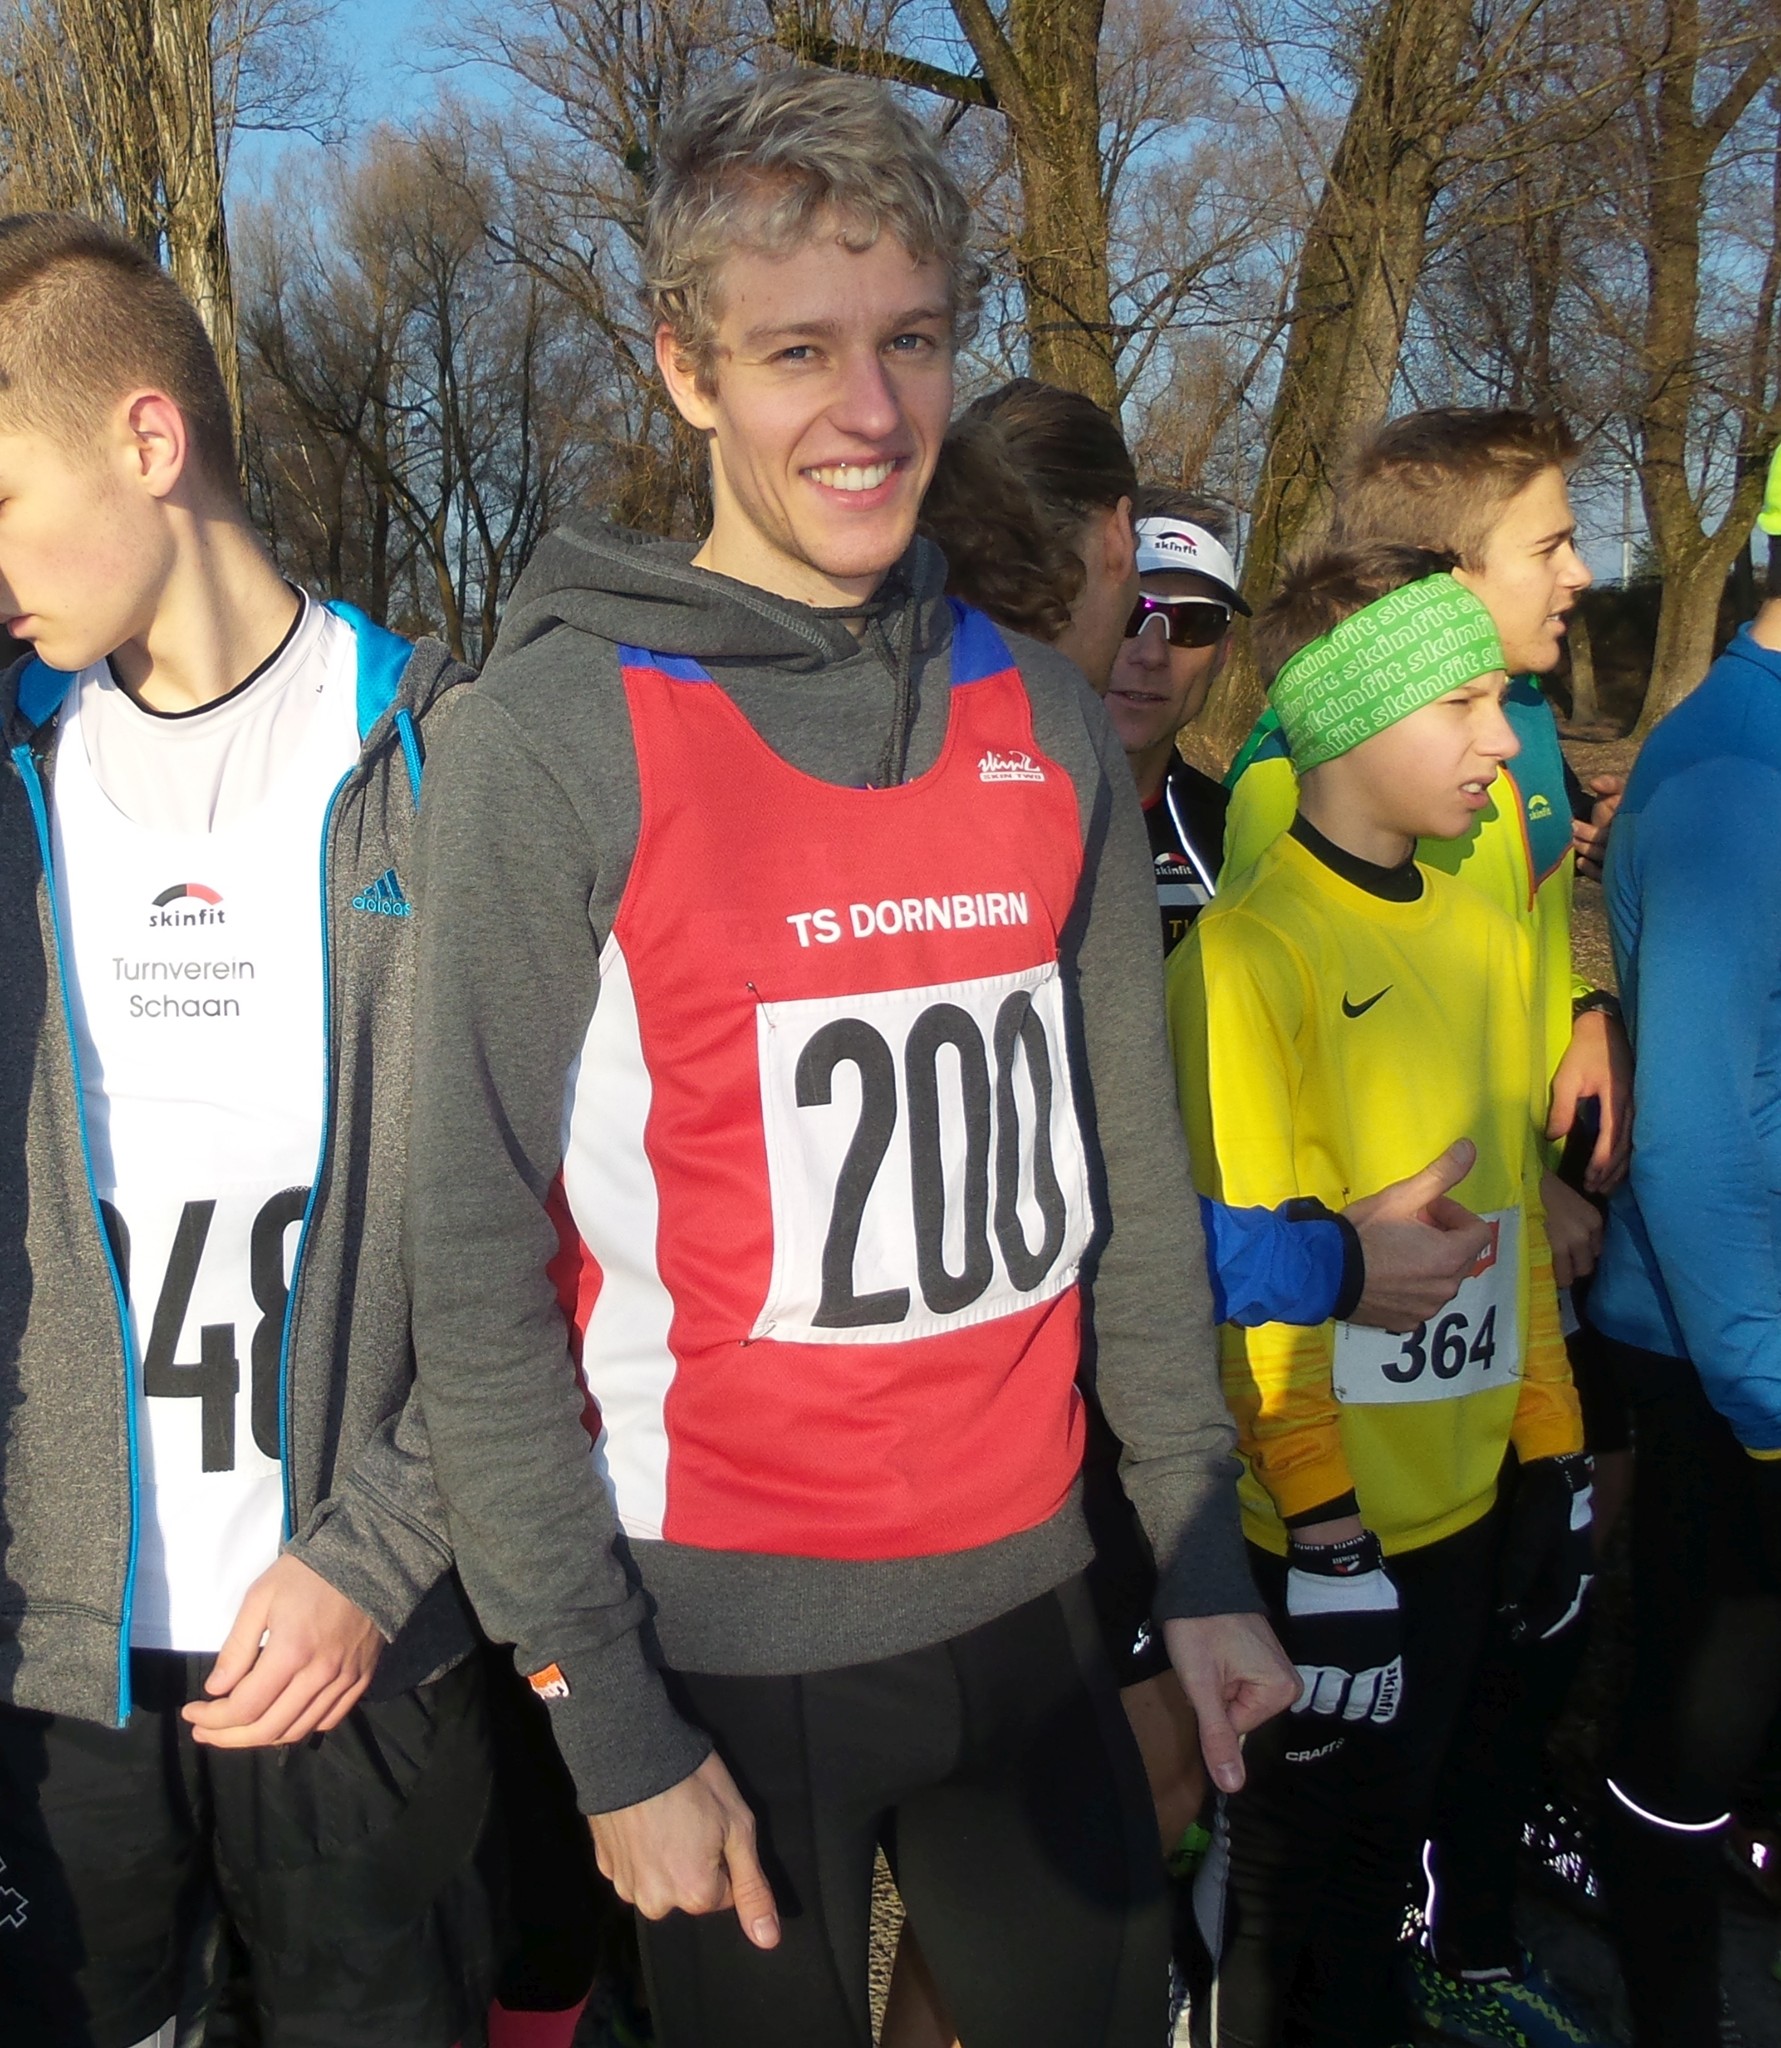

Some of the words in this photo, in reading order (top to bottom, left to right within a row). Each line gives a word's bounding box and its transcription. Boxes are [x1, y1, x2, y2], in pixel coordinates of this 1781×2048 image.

[1154, 541, 1198, 556] skinfit
[1281, 616, 1377, 692] skinfit
[1343, 601, 1458, 680] skinfit
[1302, 661, 1407, 739] skinfit
[1371, 650, 1480, 727] skinfit
[1155, 865, 1192, 875] skinfit
[149, 908, 226, 927] skinfit
[352, 897, 411, 917] adidas
[786, 907, 841, 947] TS
[849, 891, 1029, 939] DORNBIRN
[112, 957, 255, 981] Turnverein
[129, 994, 240, 1018] Schaan
[794, 989, 1067, 1328] 200
[1381, 1304, 1497, 1384] 364
[1373, 1666, 1399, 1717] skinfit
[1285, 1741, 1338, 1761] CRAFT
